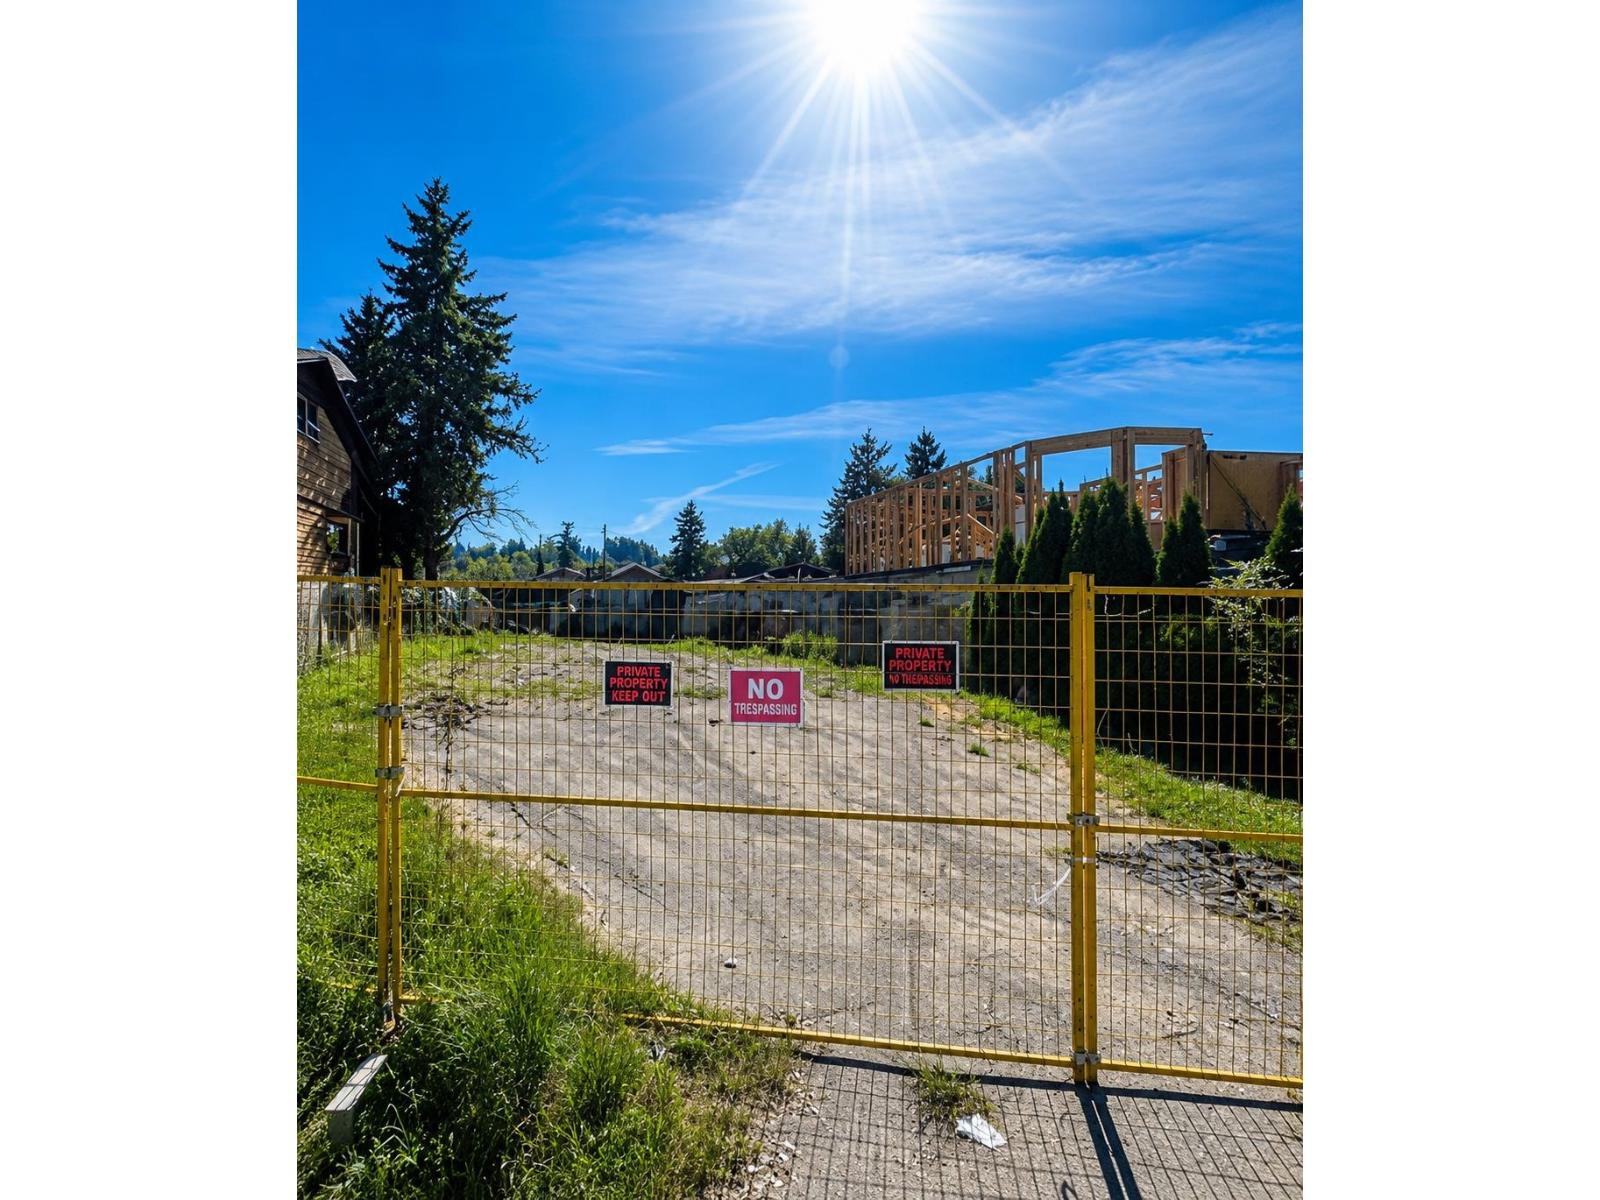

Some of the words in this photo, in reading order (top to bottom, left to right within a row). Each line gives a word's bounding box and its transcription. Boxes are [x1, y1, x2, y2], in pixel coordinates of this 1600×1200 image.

[896, 647, 945, 659] PRIVATE
[617, 666, 661, 677] PRIVATE
[889, 660, 952, 671] PROPERTY
[610, 677, 668, 689] PROPERTY
[889, 674, 899, 685] NO
[748, 678, 784, 700] NO
[612, 690, 638, 702] KEEP
[643, 691, 666, 702] OUT
[734, 703, 797, 716] TRESPASSING
